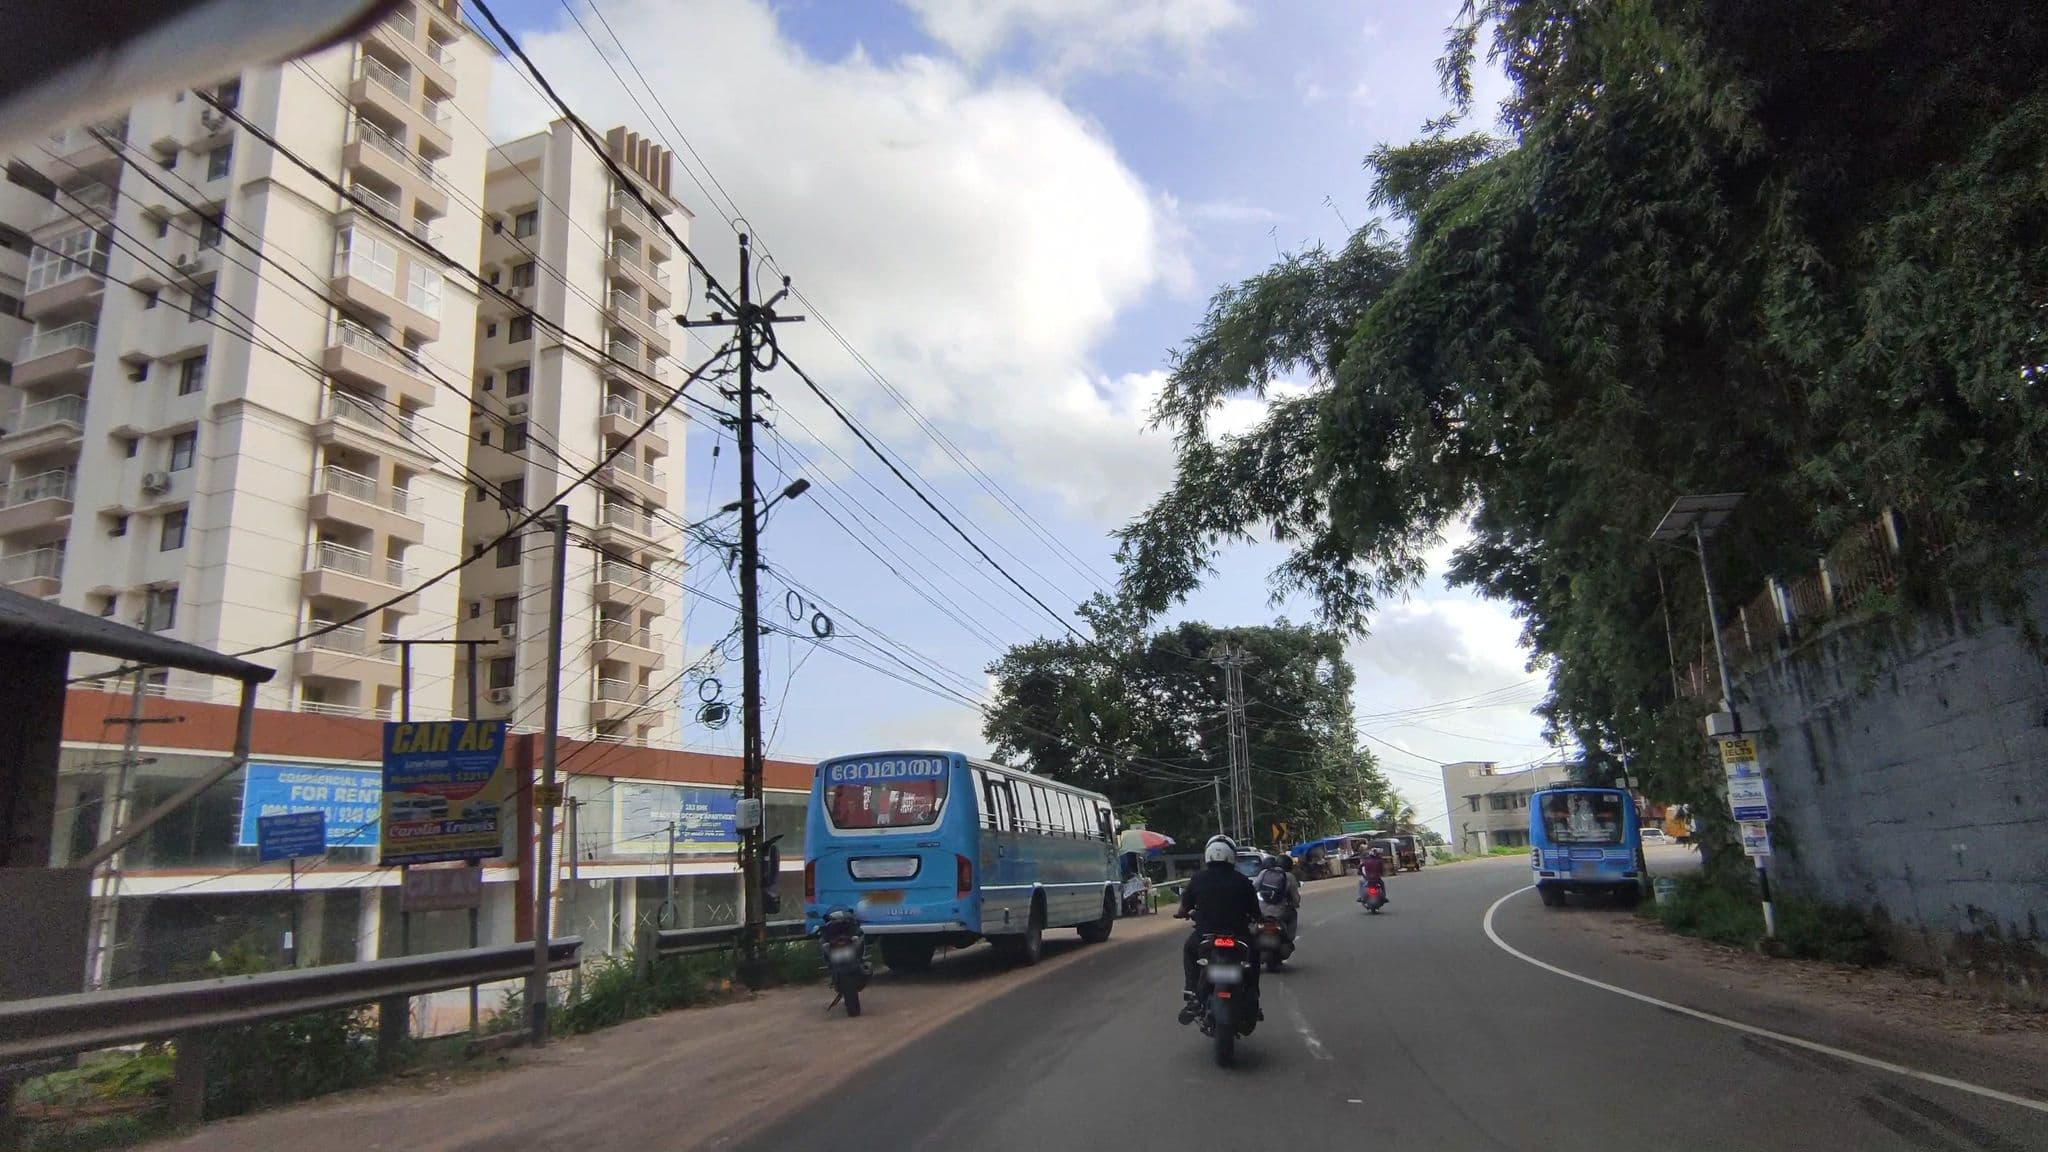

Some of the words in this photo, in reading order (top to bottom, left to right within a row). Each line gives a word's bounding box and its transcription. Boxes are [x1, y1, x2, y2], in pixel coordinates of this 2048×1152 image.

[392, 722, 450, 754] CAR
[457, 721, 497, 751] AC
[1725, 747, 1753, 757] IELTS
[831, 759, 942, 780] ദേവമാതാ
[290, 785, 328, 801] FOR
[334, 787, 382, 803] RENT
